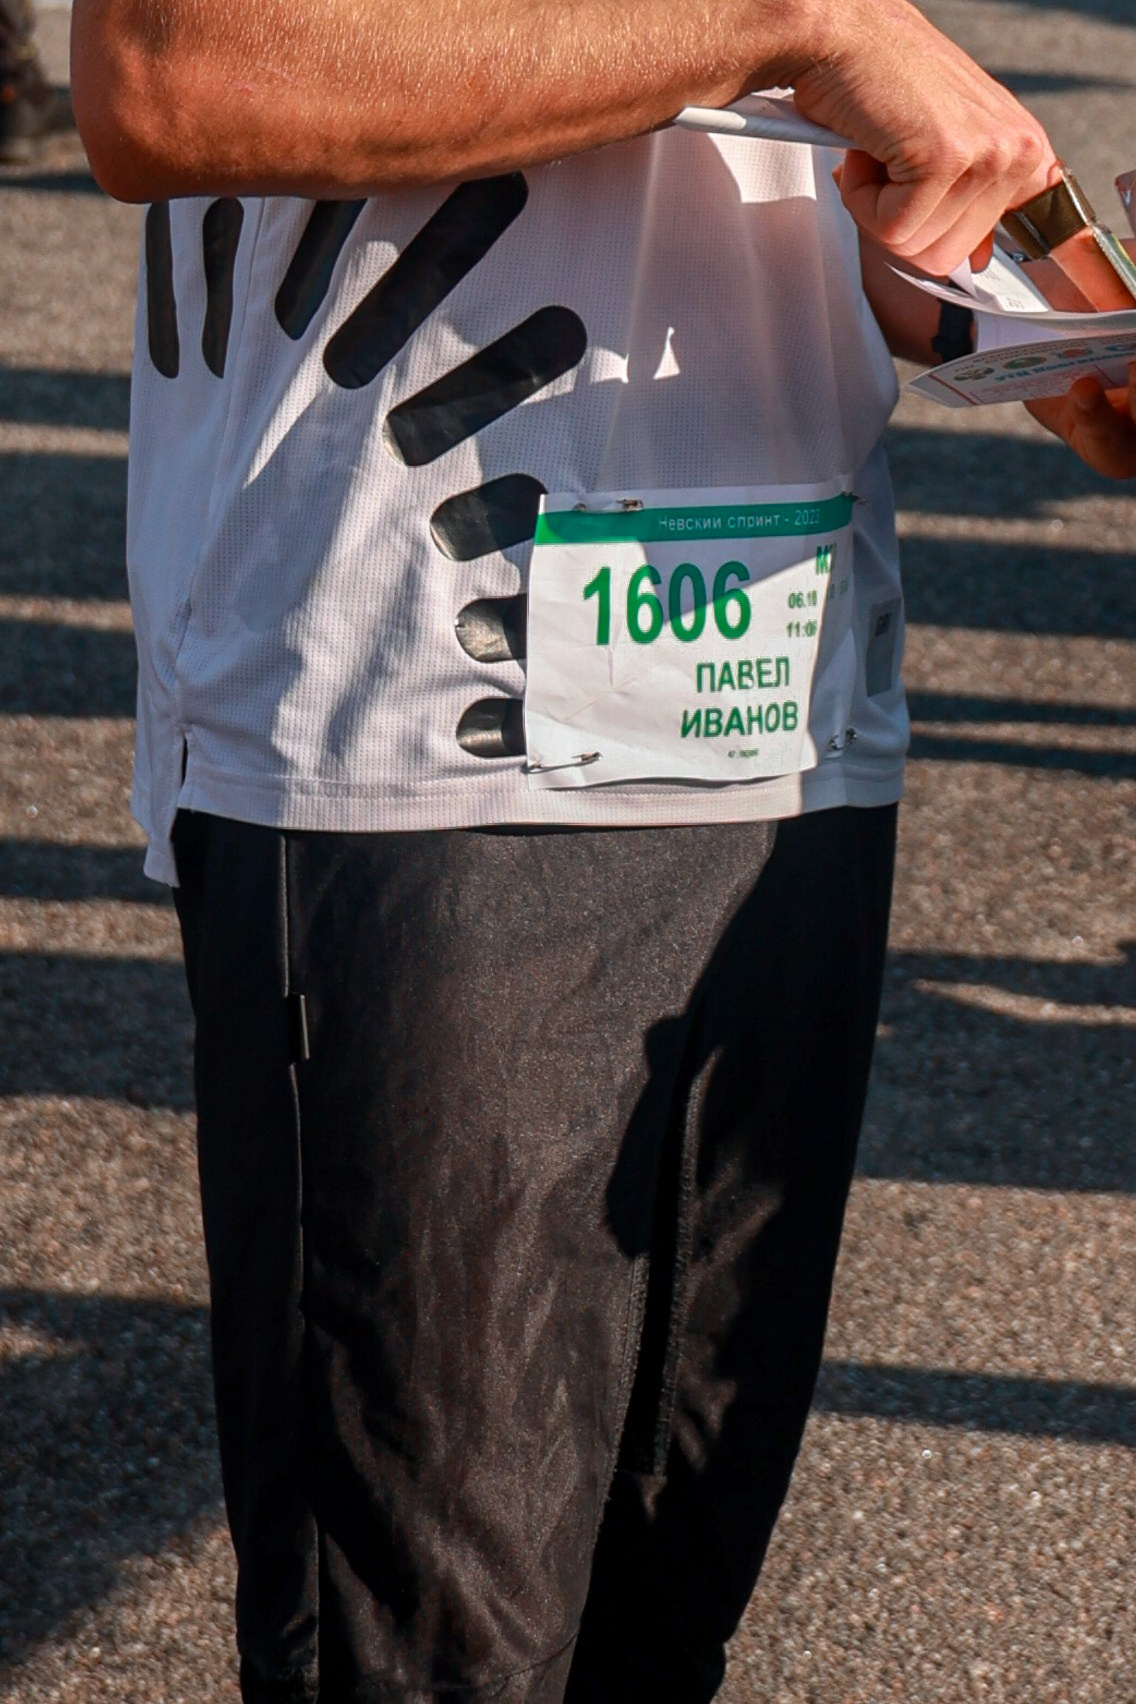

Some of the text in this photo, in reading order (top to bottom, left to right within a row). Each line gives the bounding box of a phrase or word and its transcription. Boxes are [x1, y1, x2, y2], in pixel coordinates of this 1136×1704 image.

[658, 514, 722, 531] Невский
[727, 513, 781, 529] спринт
[582, 560, 752, 646] 1606
[696, 656, 790, 694] ПАВЕЛ
[680, 700, 799, 739] ИВАНОВ
